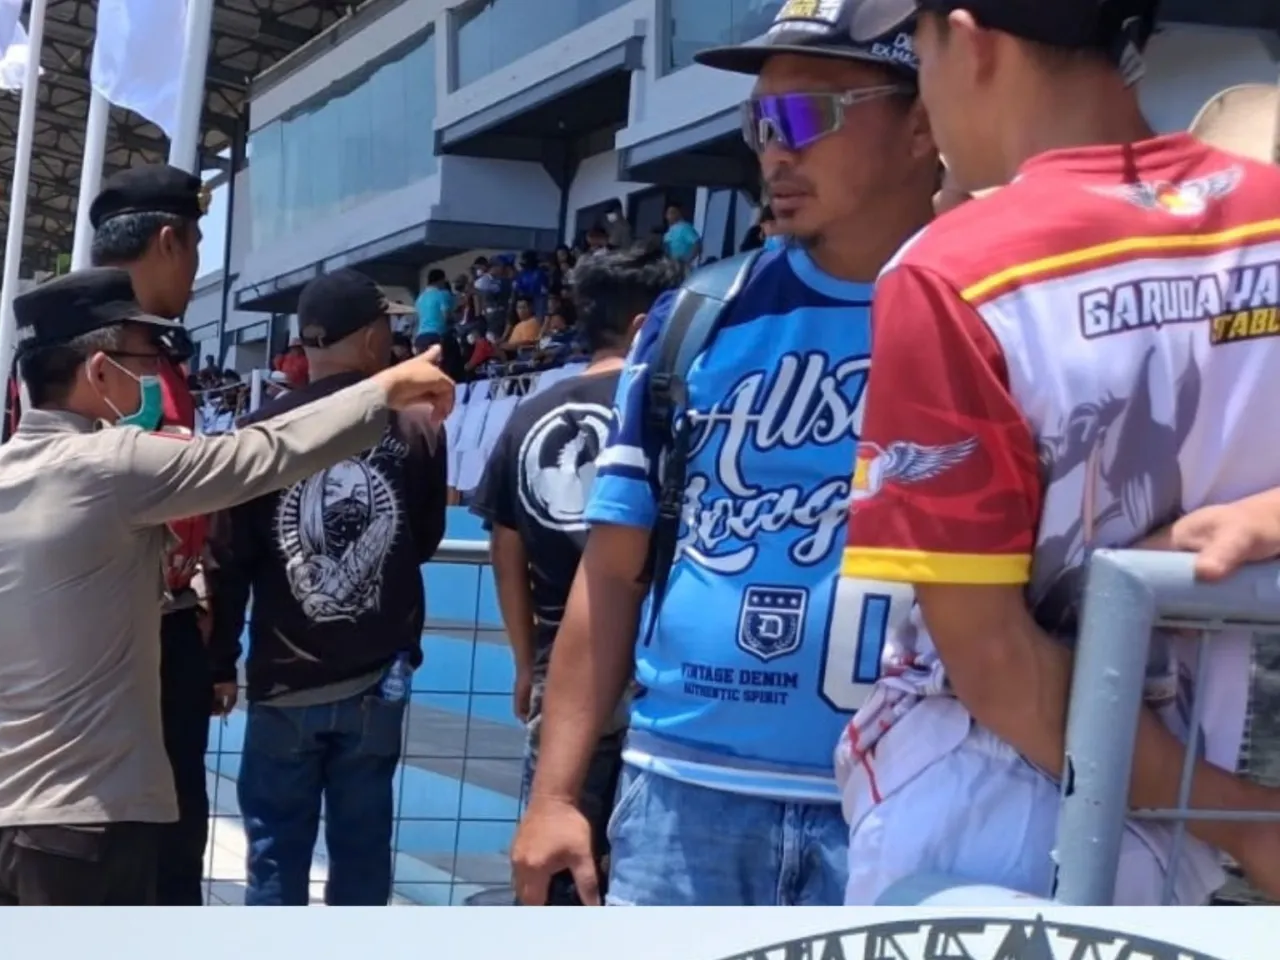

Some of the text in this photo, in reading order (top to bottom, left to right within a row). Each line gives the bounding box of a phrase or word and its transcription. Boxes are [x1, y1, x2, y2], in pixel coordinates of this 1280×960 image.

[1080, 274, 1222, 340] GARUDA
[682, 662, 799, 689] VINTAGE DENIM
[743, 690, 790, 705] SPIRIT
